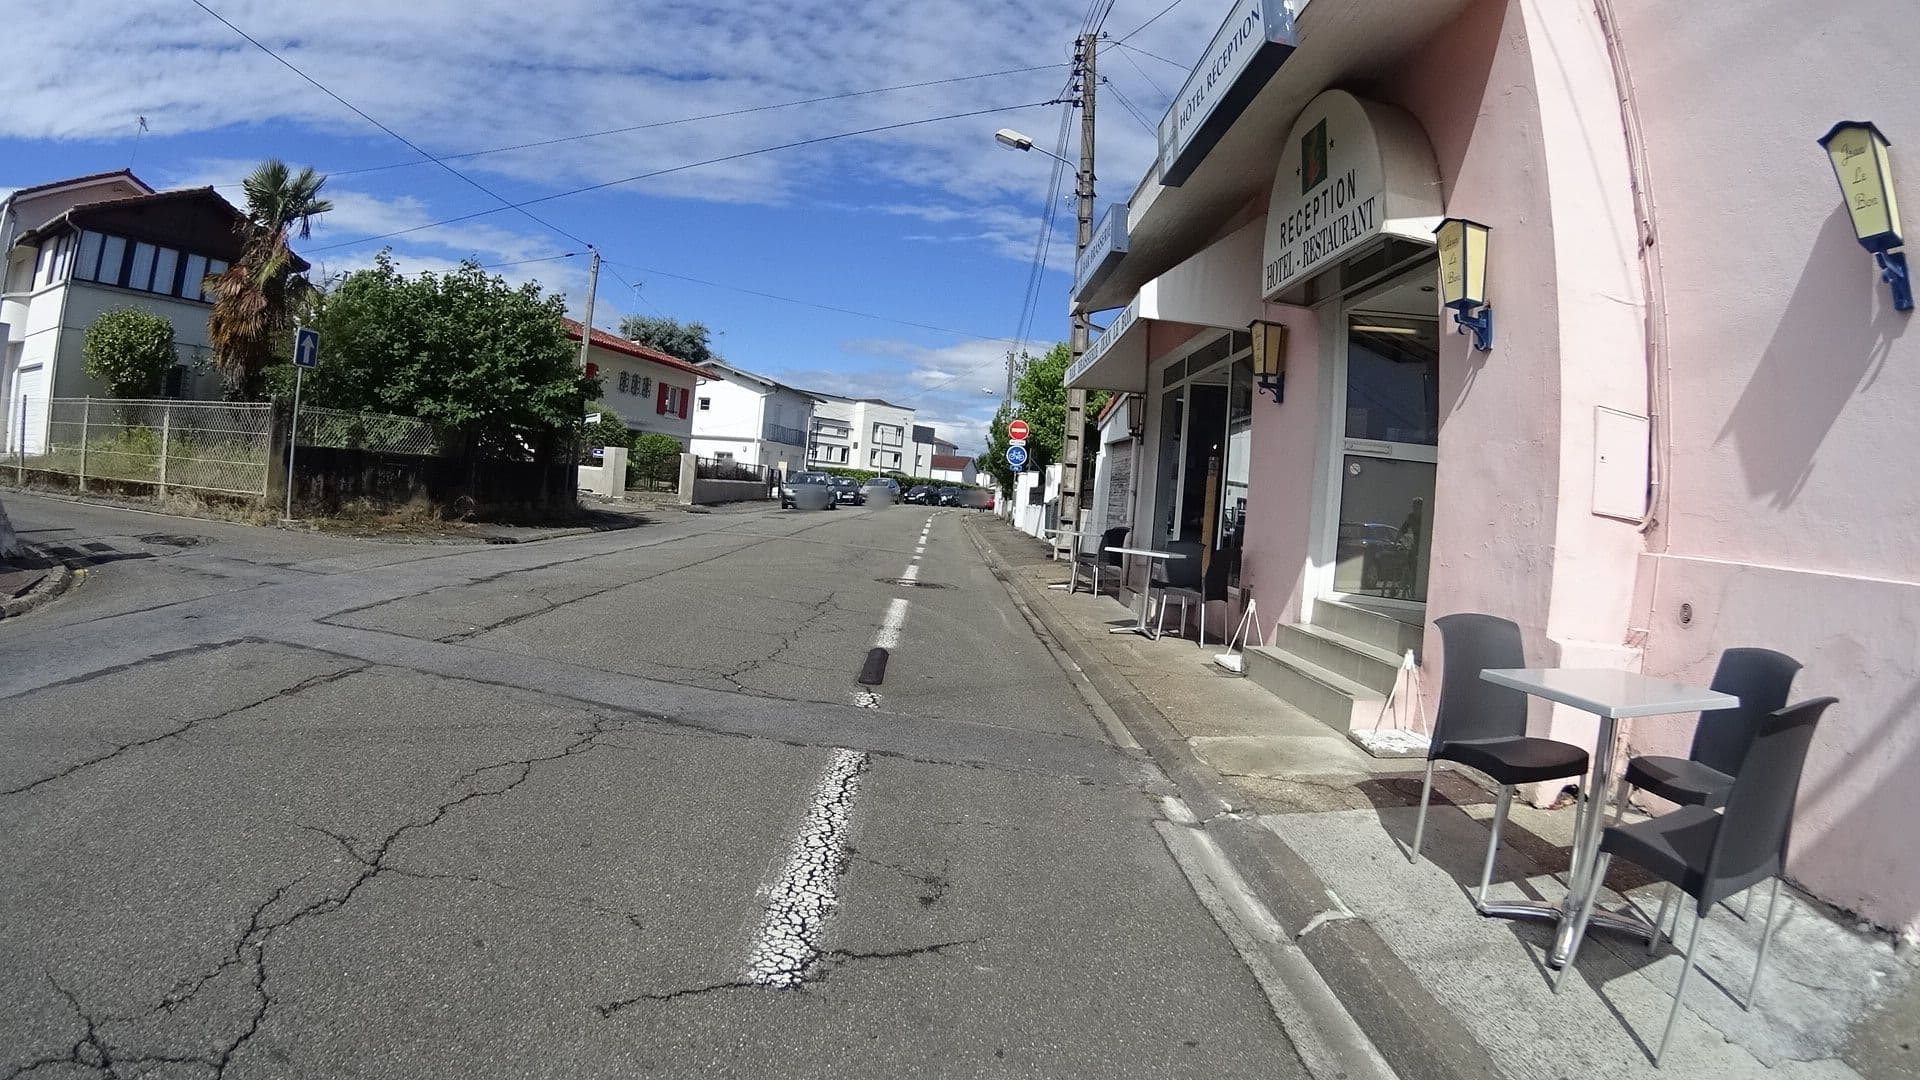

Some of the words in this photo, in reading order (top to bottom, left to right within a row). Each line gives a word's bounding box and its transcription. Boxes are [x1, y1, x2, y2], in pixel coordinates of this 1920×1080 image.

[1206, 2, 1261, 93] RÉCEPTION
[1854, 192, 1879, 210] Bon
[1266, 250, 1295, 290] HOTEL
[1302, 196, 1376, 268] RESTAURANT
[1077, 343, 1099, 374] BRASSERIE
[1113, 319, 1120, 341] LE
[1121, 304, 1133, 331] BON
